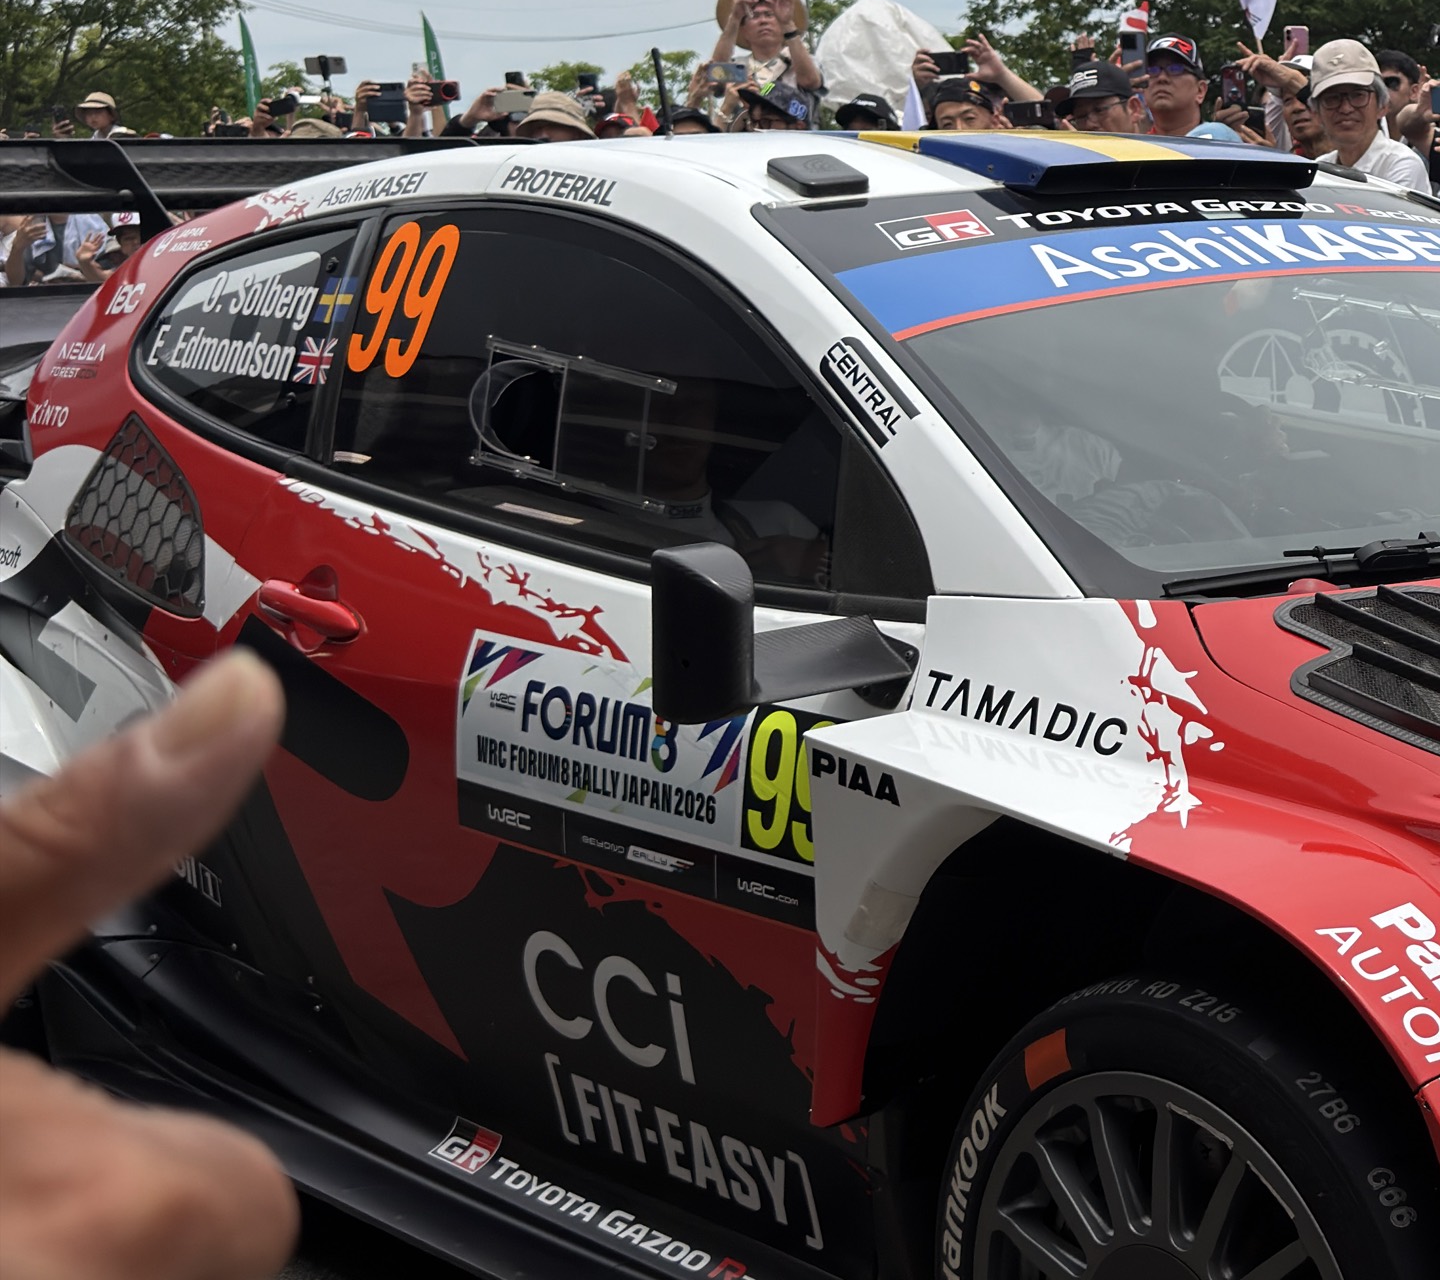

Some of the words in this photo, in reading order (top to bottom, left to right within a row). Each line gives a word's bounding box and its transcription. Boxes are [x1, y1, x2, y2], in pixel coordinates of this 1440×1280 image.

[318, 171, 428, 208] AsahiKASEI
[500, 165, 619, 207] PROTERIAL
[995, 200, 1188, 229] TOYOTA
[1190, 198, 1335, 215] GAZOO
[169, 240, 212, 252] AIRLINES
[177, 227, 208, 239] JAPAN
[893, 218, 991, 246] GR
[229, 270, 320, 331] Solberg
[348, 221, 461, 378] 99
[170, 324, 298, 382] Edmondson
[827, 340, 902, 436] CENTRAL
[490, 690, 516, 707] WRC
[520, 679, 680, 773] FORUM8
[925, 669, 1129, 756] TAMADIC
[477, 734, 507, 769] WRC
[509, 745, 570, 787] FORUM8
[571, 760, 622, 797] RALLY
[622, 775, 674, 816] JAPAN
[674, 786, 717, 825] 2026
[811, 748, 901, 807] PIAA
[487, 803, 532, 832] WRC
[582, 835, 625, 855] BEYOND
[632, 849, 668, 867] RALLY
[521, 930, 697, 1085] CCi
[1141, 979, 1176, 1000] RD
[1178, 987, 1243, 1023] Z215
[1296, 1071, 1362, 1134] 27B6
[435, 1136, 492, 1172] GR
[489, 1156, 600, 1222] TOYOTA
[597, 1209, 712, 1272] GAZOO
[1366, 1166, 1418, 1229] G66
